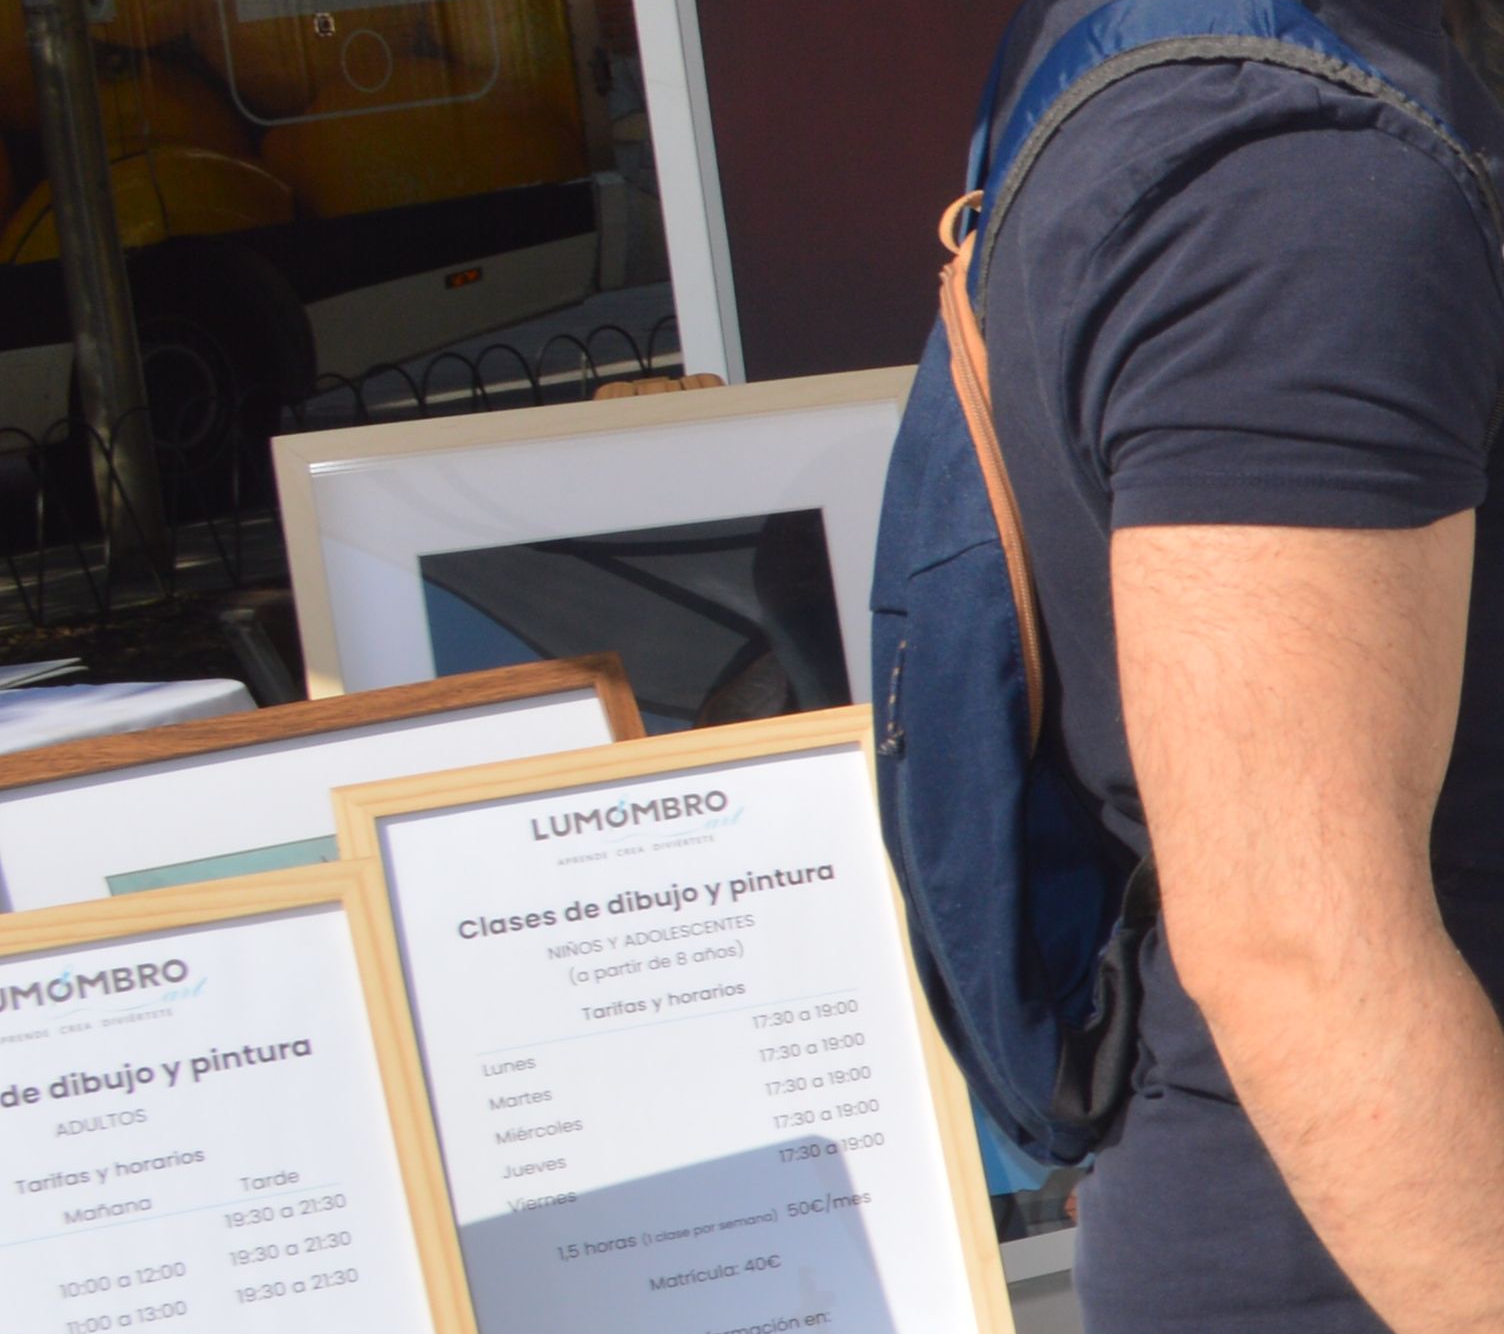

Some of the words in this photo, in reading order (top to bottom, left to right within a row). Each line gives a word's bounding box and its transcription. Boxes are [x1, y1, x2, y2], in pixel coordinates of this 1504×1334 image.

[531, 789, 728, 841] LUMOMBRO
[616, 846, 645, 858] CREA
[457, 907, 557, 941] Clases
[564, 899, 601, 924] de
[607, 879, 699, 916] dibujo
[704, 879, 723, 907] y
[729, 862, 836, 903] pintura
[547, 933, 604, 962] NIÑOS
[608, 936, 619, 951] Y
[623, 912, 757, 949] ADOLESCENTES
[569, 964, 591, 988] (a
[594, 955, 643, 985] partir
[648, 953, 672, 972] de
[676, 950, 688, 966] 8
[693, 938, 745, 966] años)
[581, 996, 648, 1023] Tarifas
[652, 994, 664, 1014] y
[668, 980, 747, 1008] horarios
[751, 1009, 796, 1030] 17:30
[798, 1008, 812, 1022] a
[814, 998, 860, 1019] 19:00
[59, 1022, 92, 1035] CREA
[757, 1042, 803, 1064] 17:30
[805, 1041, 819, 1055] a
[821, 1031, 866, 1053] 19:00
[0, 1084, 41, 1108] de
[49, 1061, 156, 1100] dibujo
[162, 1060, 182, 1088] y
[190, 1036, 313, 1083] pintura
[481, 1055, 537, 1079] Lunes
[764, 1076, 808, 1097] 17:30
[811, 1074, 826, 1088] a
[827, 1064, 873, 1086] 19:00
[488, 1087, 554, 1113] Martes
[772, 1109, 817, 1130] 17:30
[819, 1107, 834, 1122] a
[835, 1097, 881, 1119] 19:00
[55, 1107, 149, 1139] ADULTOS
[494, 1115, 585, 1147] Miércoles
[777, 1142, 822, 1164] 17:30
[824, 1141, 839, 1156] a
[841, 1131, 886, 1153] 19:00
[15, 1167, 92, 1195] Tarifas
[95, 1164, 110, 1185] y
[115, 1146, 206, 1178] horarios
[239, 1169, 301, 1193] Tarde
[500, 1154, 568, 1181] Jueves
[63, 1196, 153, 1226] Mañana
[224, 1205, 276, 1230] 19:30
[280, 1204, 295, 1220] a
[298, 1192, 348, 1218] 21:30
[506, 1188, 579, 1215] Viernes
[556, 1244, 581, 1264] 1,5
[584, 1233, 638, 1257] horas
[641, 1232, 654, 1248] (1
[654, 1226, 691, 1245] clase
[693, 1222, 717, 1240] por
[718, 1207, 779, 1233] semana)
[786, 1188, 873, 1219] 50€/mes
[229, 1242, 280, 1268] 19:30
[285, 1241, 300, 1257] a
[303, 1230, 353, 1255] 21:30
[59, 1275, 112, 1300] 10:00
[117, 1273, 132, 1288] a
[135, 1261, 188, 1286] 12:00
[235, 1280, 287, 1305] 19:30
[291, 1278, 307, 1295] a
[310, 1267, 360, 1292] 21:30
[648, 1262, 740, 1293] Matrícula:
[743, 1253, 782, 1273] 40€
[118, 1312, 133, 1328] a
[136, 1299, 189, 1324] 13:00
[804, 1309, 832, 1327] en:
